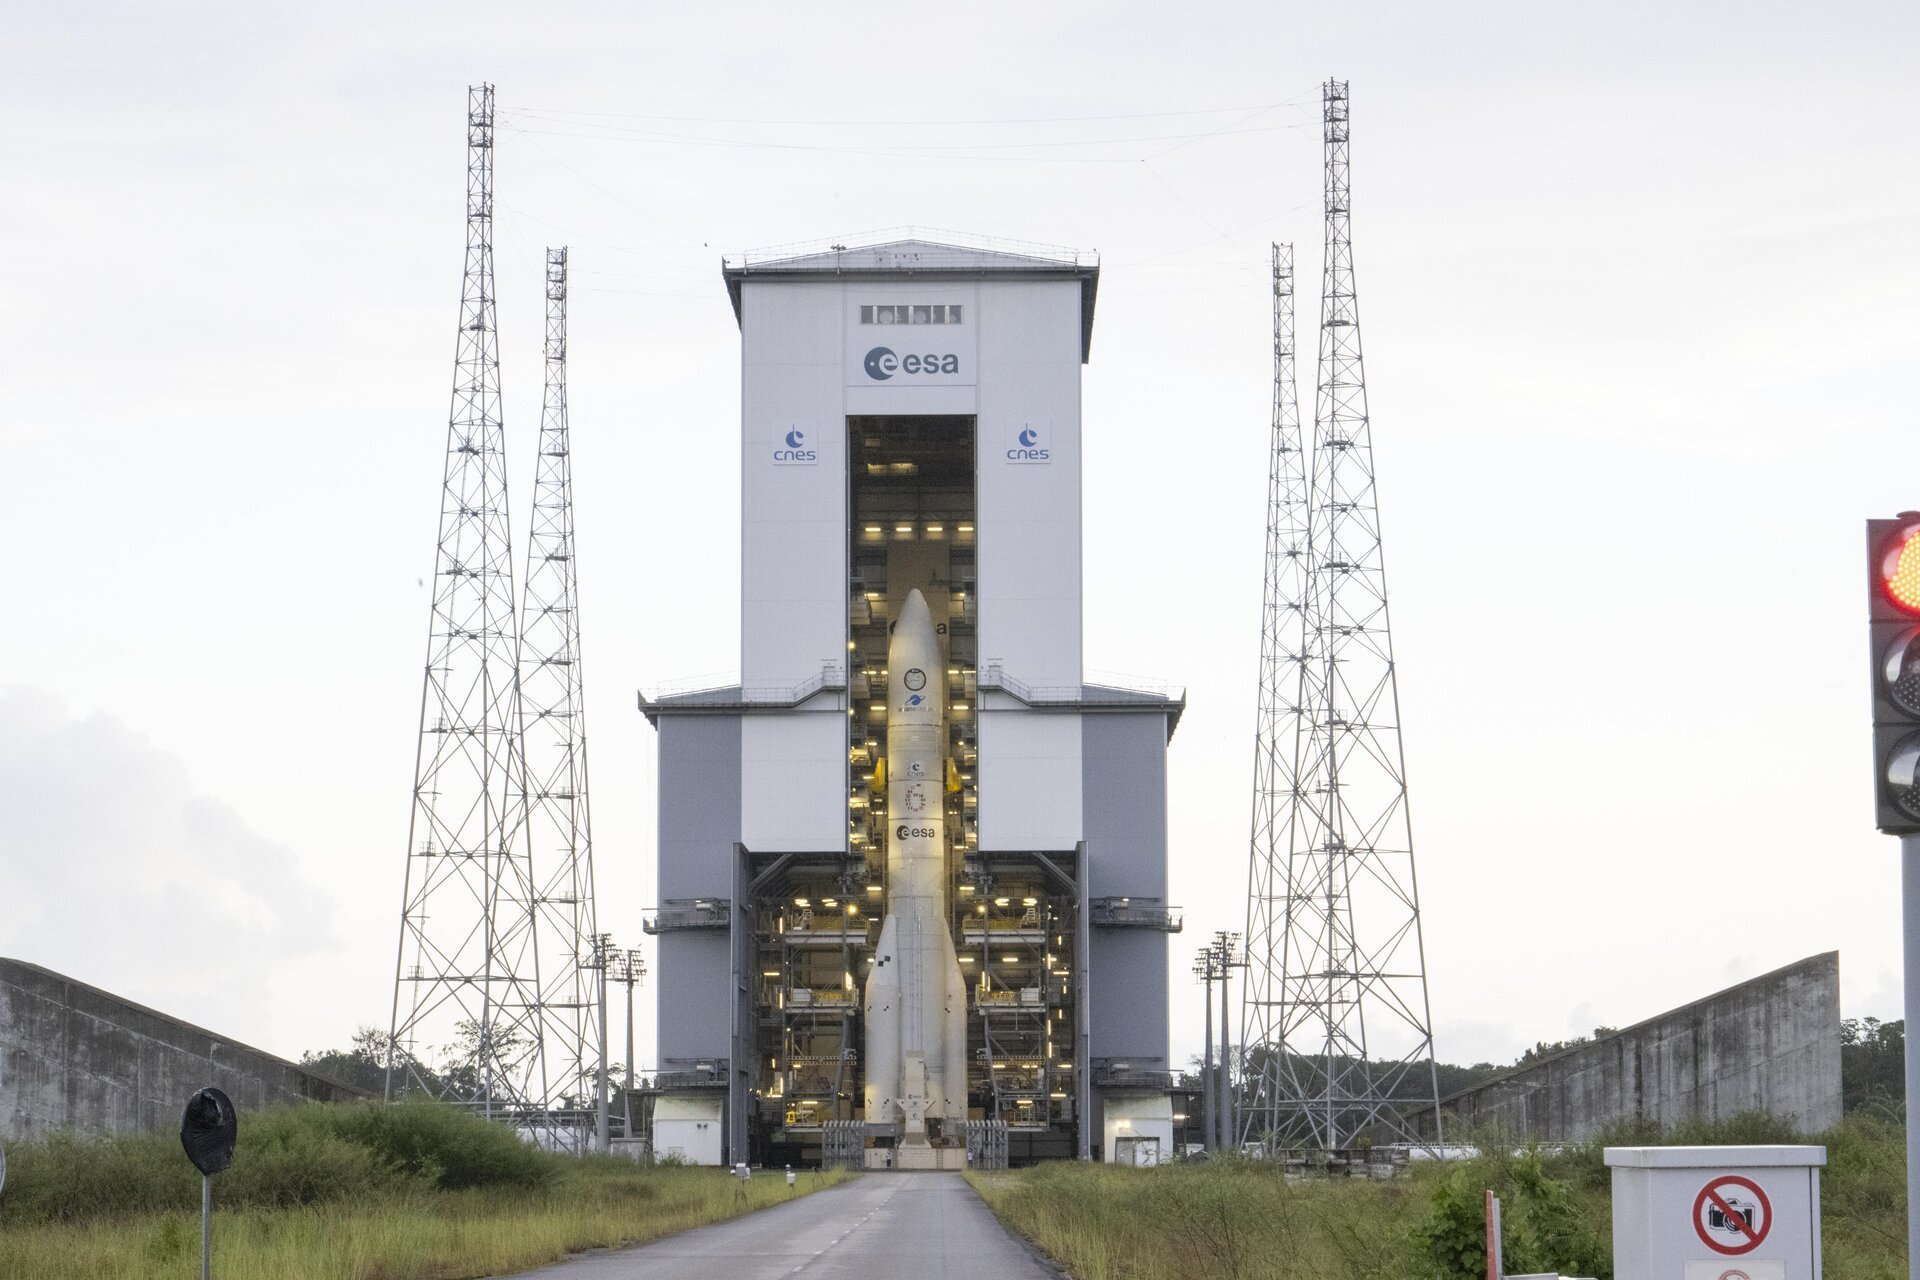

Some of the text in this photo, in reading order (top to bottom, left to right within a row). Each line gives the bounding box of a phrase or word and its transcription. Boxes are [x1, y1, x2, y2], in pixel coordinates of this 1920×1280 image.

[902, 353, 959, 375] esa
[774, 449, 816, 461] cnes
[1007, 448, 1049, 460] cnes
[911, 828, 935, 838] esa
